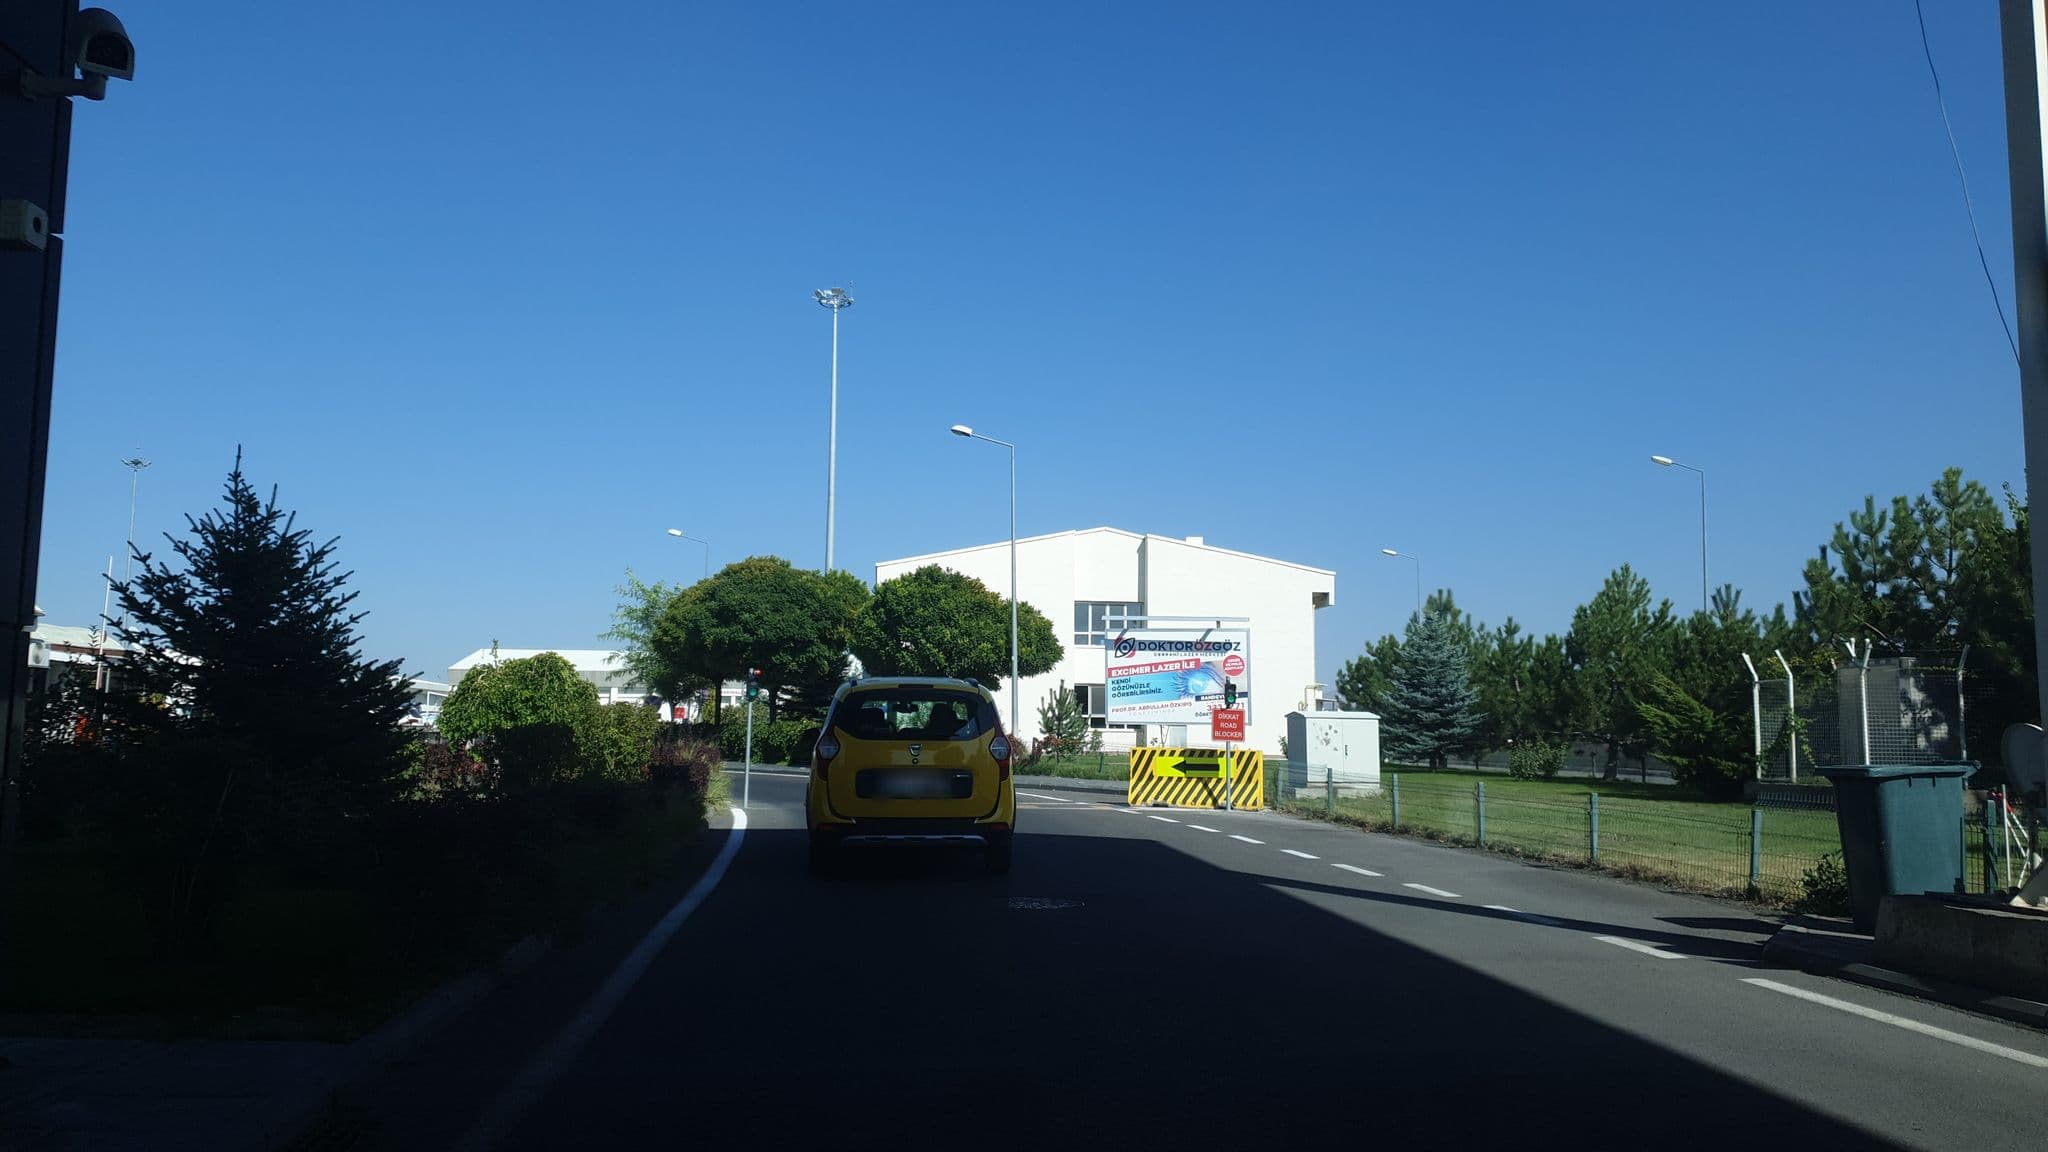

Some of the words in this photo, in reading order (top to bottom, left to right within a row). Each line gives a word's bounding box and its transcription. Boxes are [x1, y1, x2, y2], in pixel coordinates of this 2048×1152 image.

[1111, 665, 1151, 677] EXCİMER
[1152, 663, 1180, 673] LAZER
[1182, 660, 1196, 669] İLE
[1111, 677, 1131, 685] KENDİ
[1111, 682, 1151, 692] GÖZÜNÜZLE
[1138, 703, 1169, 711] ABDULLAH
[1218, 712, 1239, 720] DİKKAT
[1214, 730, 1243, 738] BLOCKER
